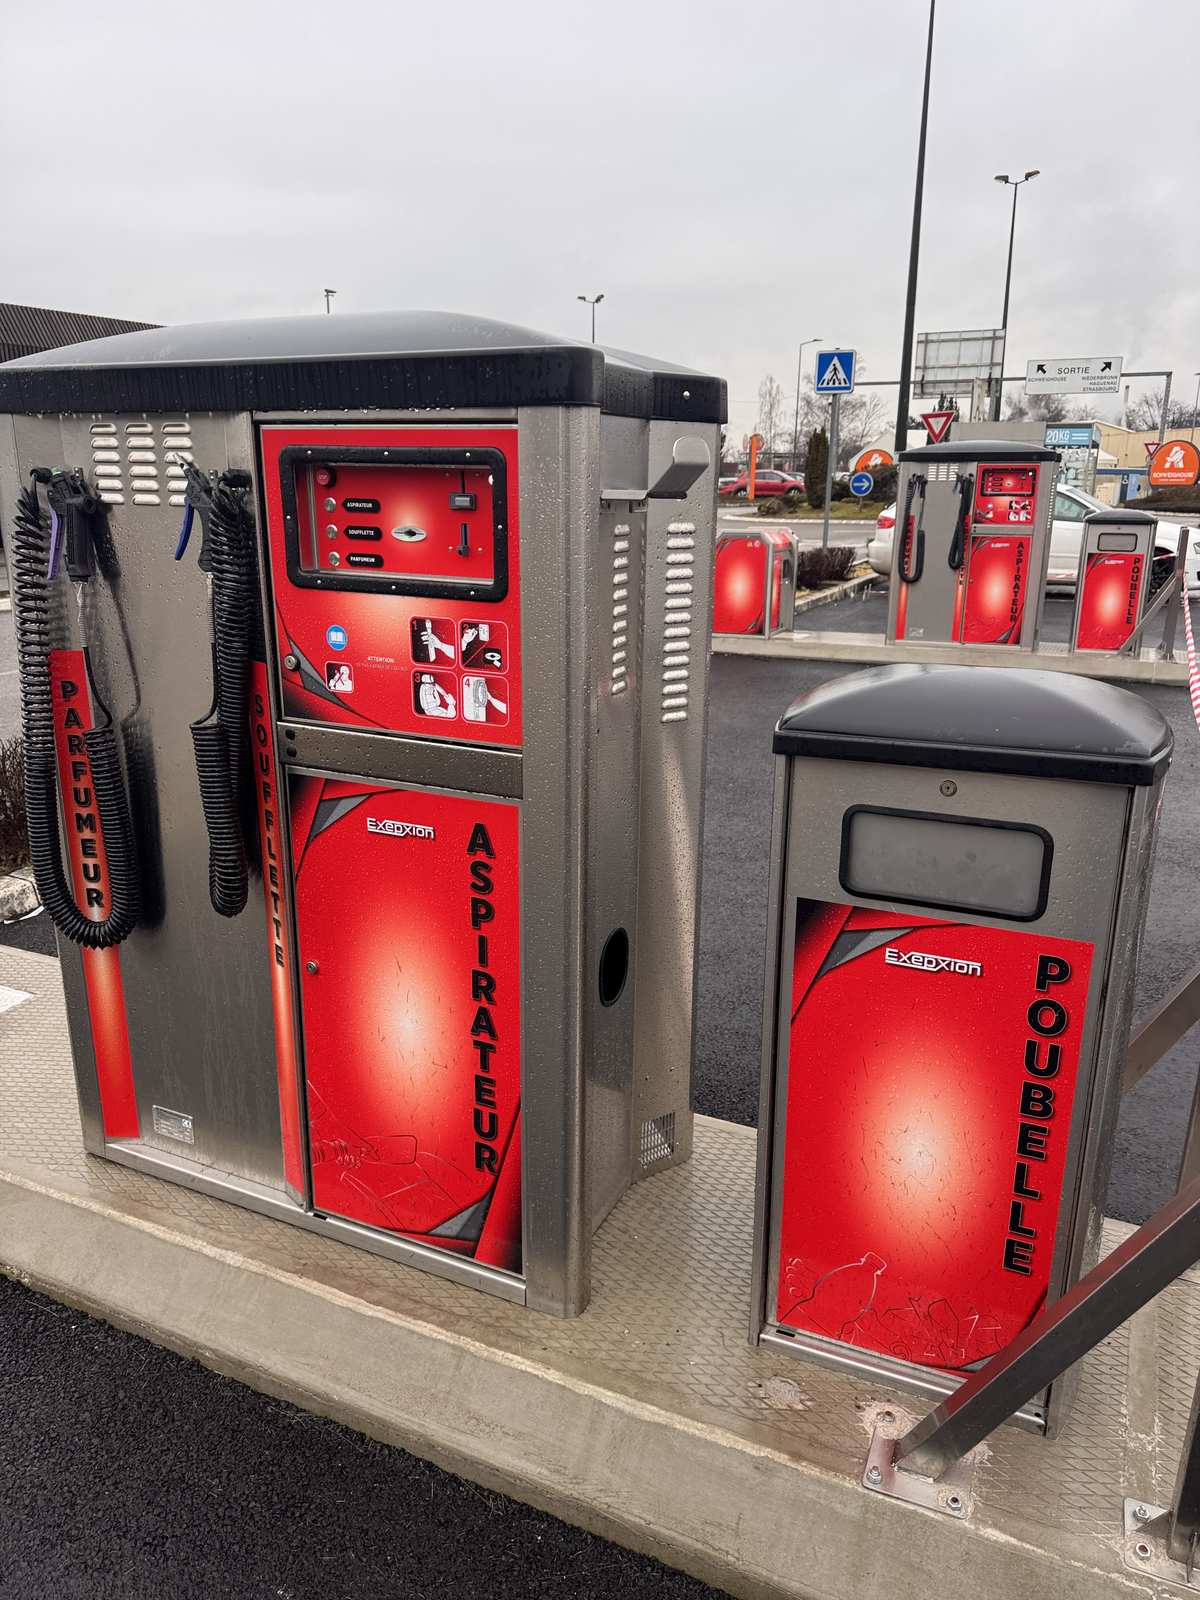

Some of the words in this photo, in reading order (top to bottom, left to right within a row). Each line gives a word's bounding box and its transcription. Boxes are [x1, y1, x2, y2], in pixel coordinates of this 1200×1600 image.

[1057, 366, 1090, 374] SORTIE
[1009, 541, 1025, 623] ASPIRATEUR
[1126, 557, 1141, 625] POUBELLE
[60, 680, 104, 908] PARFUMEUR
[254, 694, 285, 968] SOUFFLETTE
[467, 822, 499, 1176] ASPIRATEUR
[1002, 953, 1072, 1276] POUBELLE
